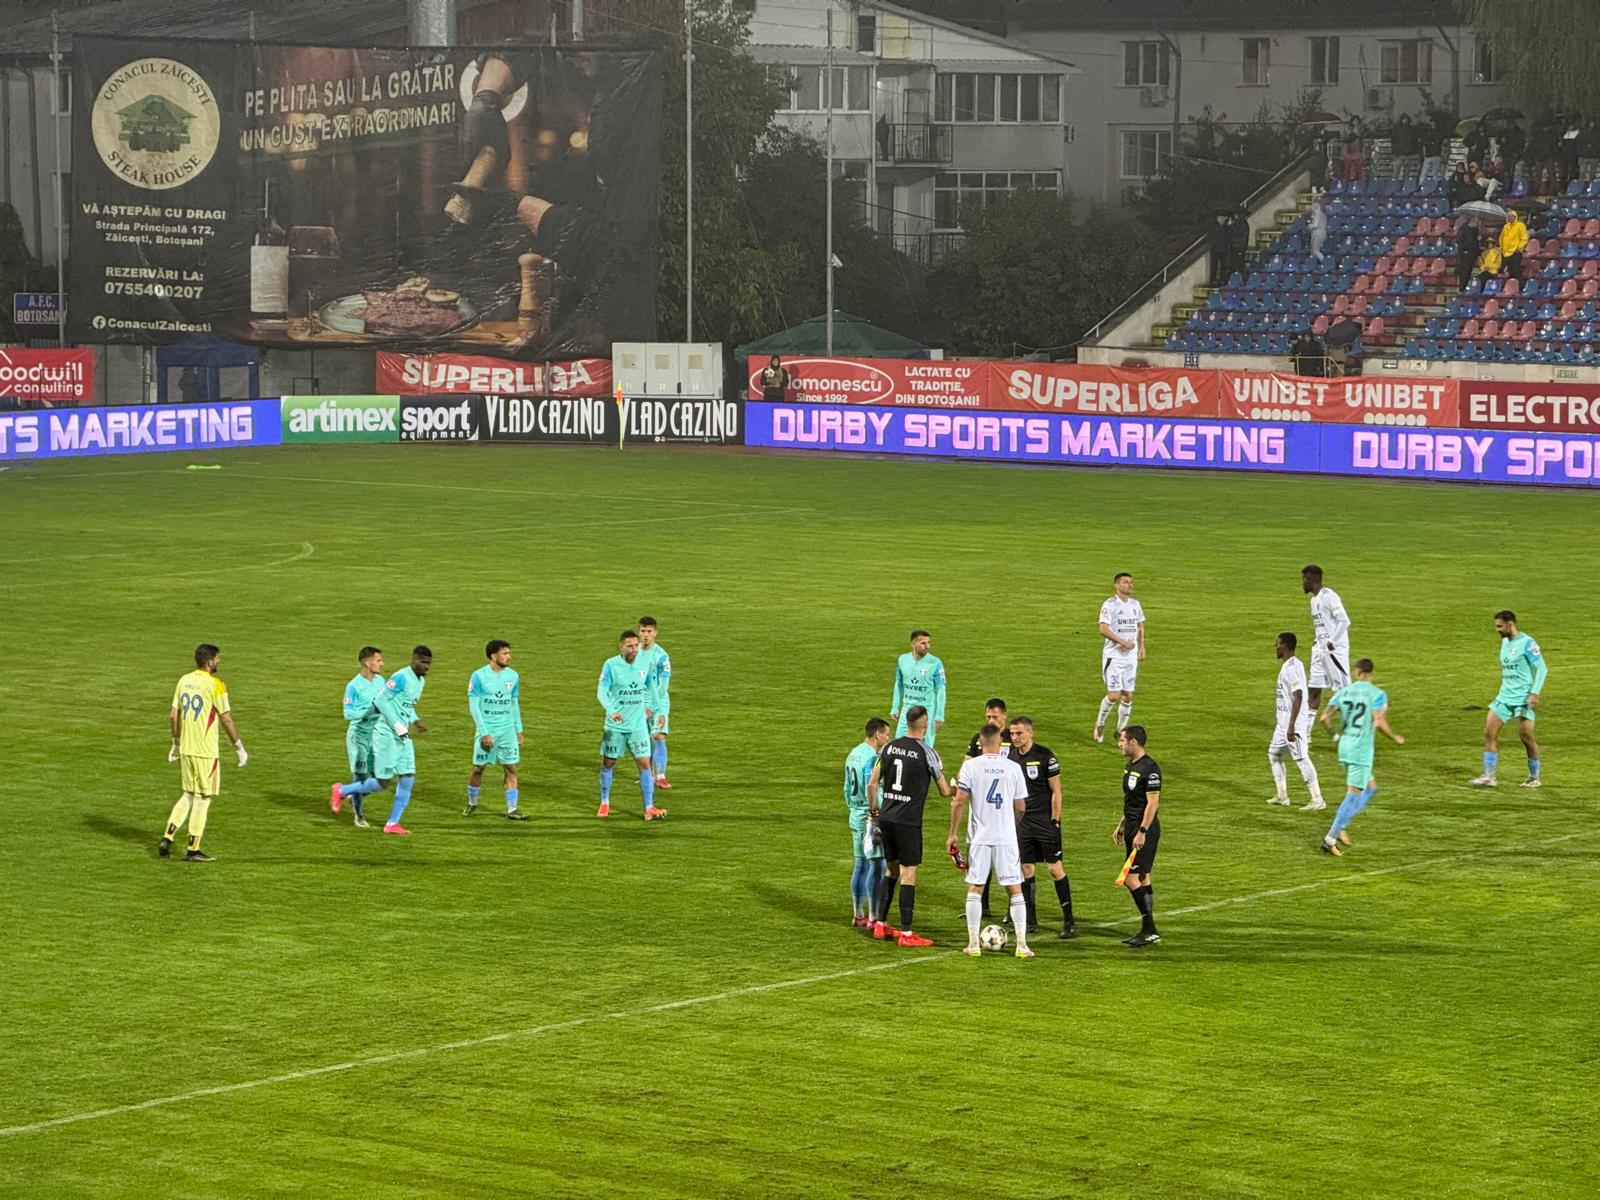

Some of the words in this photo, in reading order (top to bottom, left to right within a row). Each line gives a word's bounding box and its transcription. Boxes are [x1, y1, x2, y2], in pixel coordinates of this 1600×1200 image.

[104, 63, 157, 100] CONACUL
[245, 90, 264, 117] PE
[323, 78, 355, 107] SAU
[362, 75, 382, 102] LA
[242, 128, 264, 150] UN
[270, 120, 315, 146] GUST
[321, 101, 456, 140] EXTRAORDINAR!
[108, 151, 148, 184] STEAK
[153, 154, 201, 184] HOUSE
[96, 220, 130, 230] Strada
[191, 226, 215, 236] 172,
[165, 208, 182, 218] CU
[186, 209, 226, 220] DRAG!
[105, 282, 204, 299] 0755400207
[183, 271, 204, 281] LA:
[28, 295, 55, 308] A.F.C.
[108, 317, 212, 332] ConaculZaicesti
[0, 361, 83, 381] oodwill
[401, 358, 594, 394] SUPERLIGA
[787, 374, 882, 392] lomonescu
[904, 366, 952, 377] LACTATE
[954, 367, 971, 378] CU
[14, 381, 83, 396] consulting
[796, 392, 823, 402] Since
[825, 394, 848, 403] 1992
[895, 393, 915, 404] DIN
[1008, 369, 1200, 413] SUPERLIGA
[1234, 377, 1329, 407] UNIBET
[1345, 383, 1445, 410] UNIBET
[0, 416, 39, 454] TS
[50, 406, 252, 451] MARKETING
[288, 400, 397, 433] artimex
[401, 399, 471, 436] sport
[484, 395, 536, 439] VLAD
[538, 397, 605, 441] CAZINO
[670, 399, 738, 443] CAZINO
[401, 429, 471, 440] equipment
[773, 408, 893, 446] DURBY
[904, 413, 1049, 454] SPORTS
[1061, 419, 1285, 464] MARKETING
[1353, 431, 1494, 474] DURBY
[1507, 438, 1600, 479] SPO
[181, 692, 204, 722] 99
[1342, 700, 1367, 730] 72
[891, 758, 903, 791] 1
[986, 778, 1004, 809] 4
